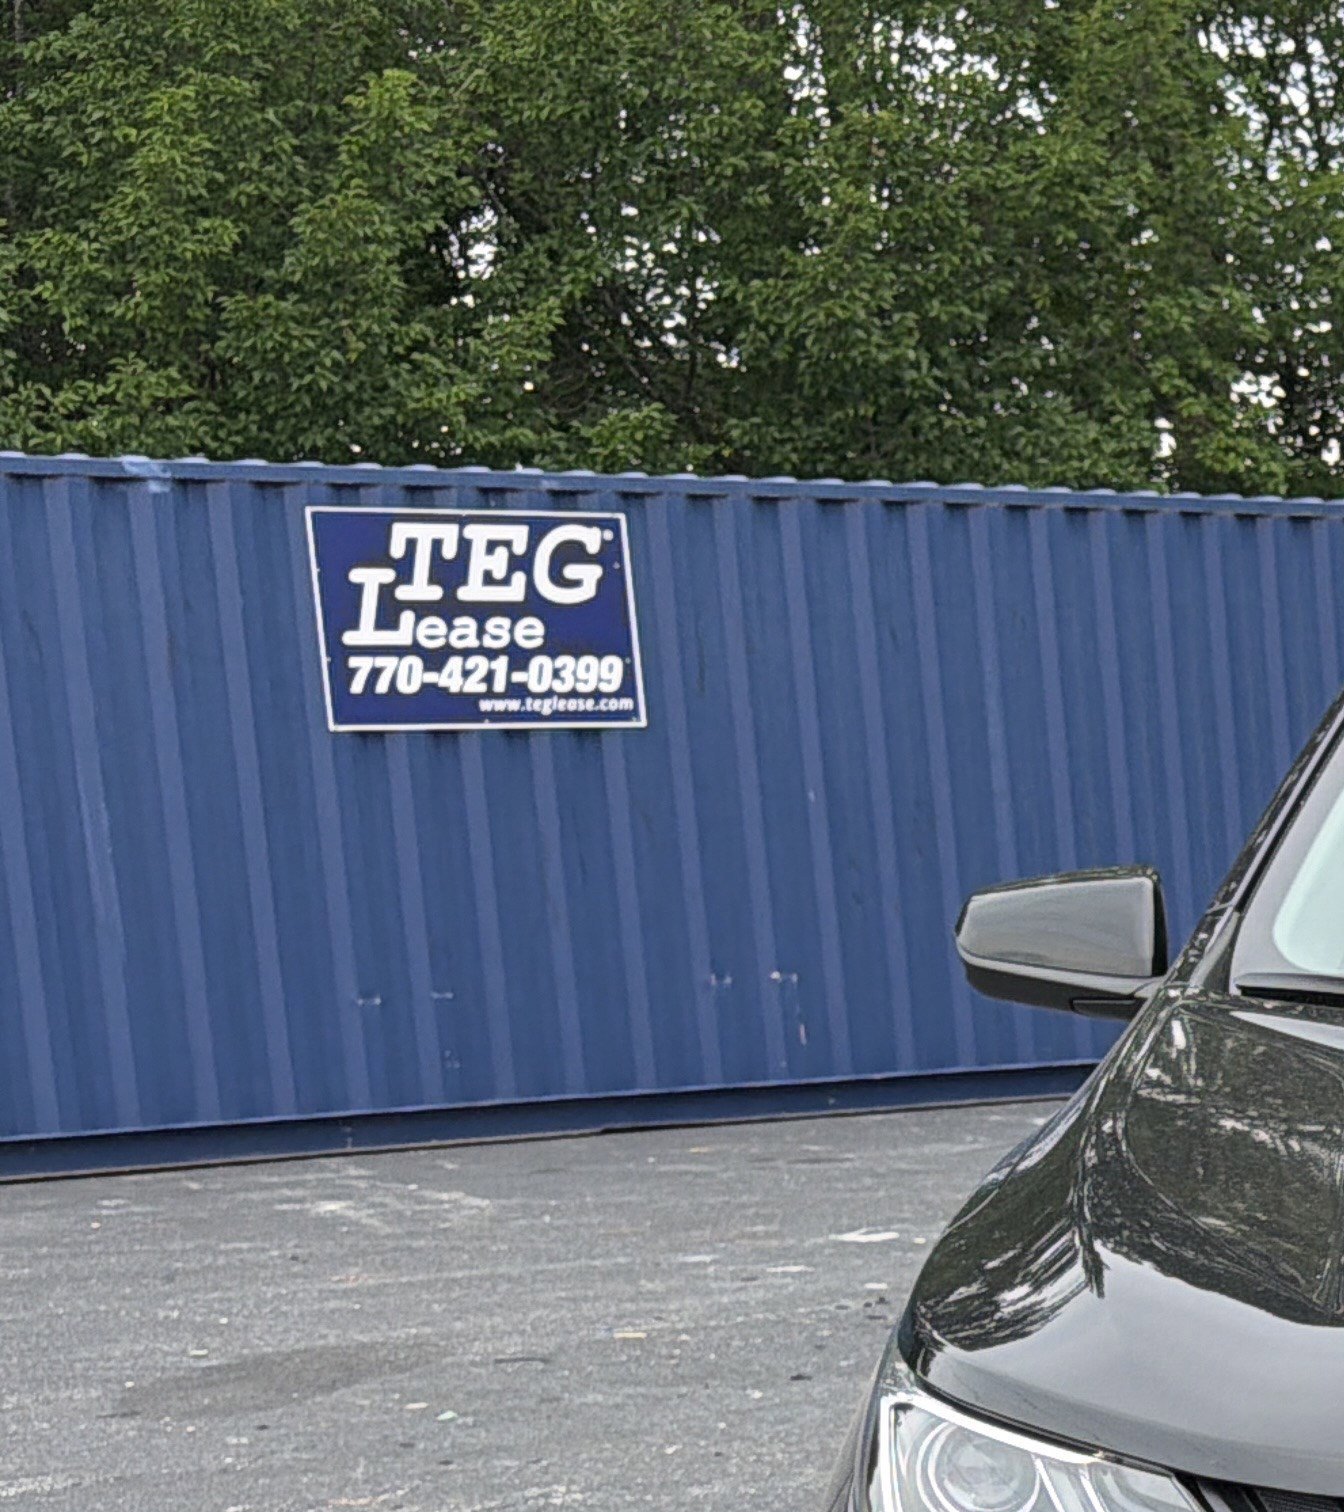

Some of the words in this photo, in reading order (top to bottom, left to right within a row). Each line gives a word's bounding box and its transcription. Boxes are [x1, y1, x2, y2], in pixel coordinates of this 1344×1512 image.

[342, 568, 545, 648] Lease
[348, 655, 623, 694] 770-421-0399
[479, 695, 634, 716] www.teglease.com
